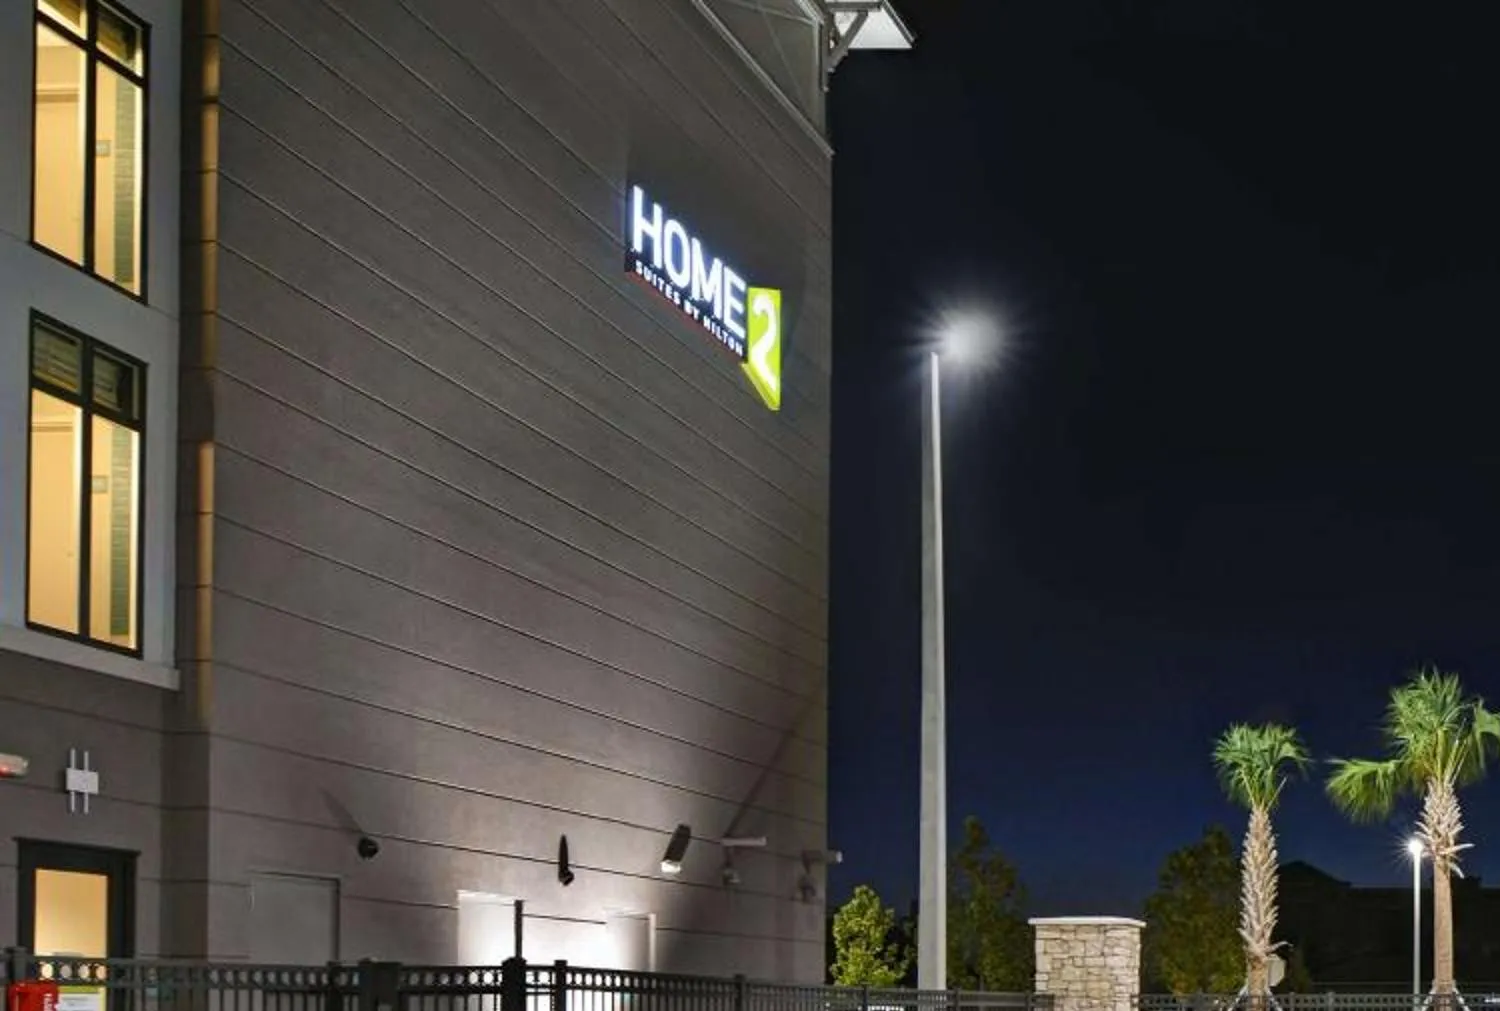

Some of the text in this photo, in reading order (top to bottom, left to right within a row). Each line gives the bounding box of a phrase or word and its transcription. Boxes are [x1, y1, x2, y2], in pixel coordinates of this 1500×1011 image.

[632, 185, 778, 394] HOME 2
[635, 259, 744, 357] SUITES BY HILTON
